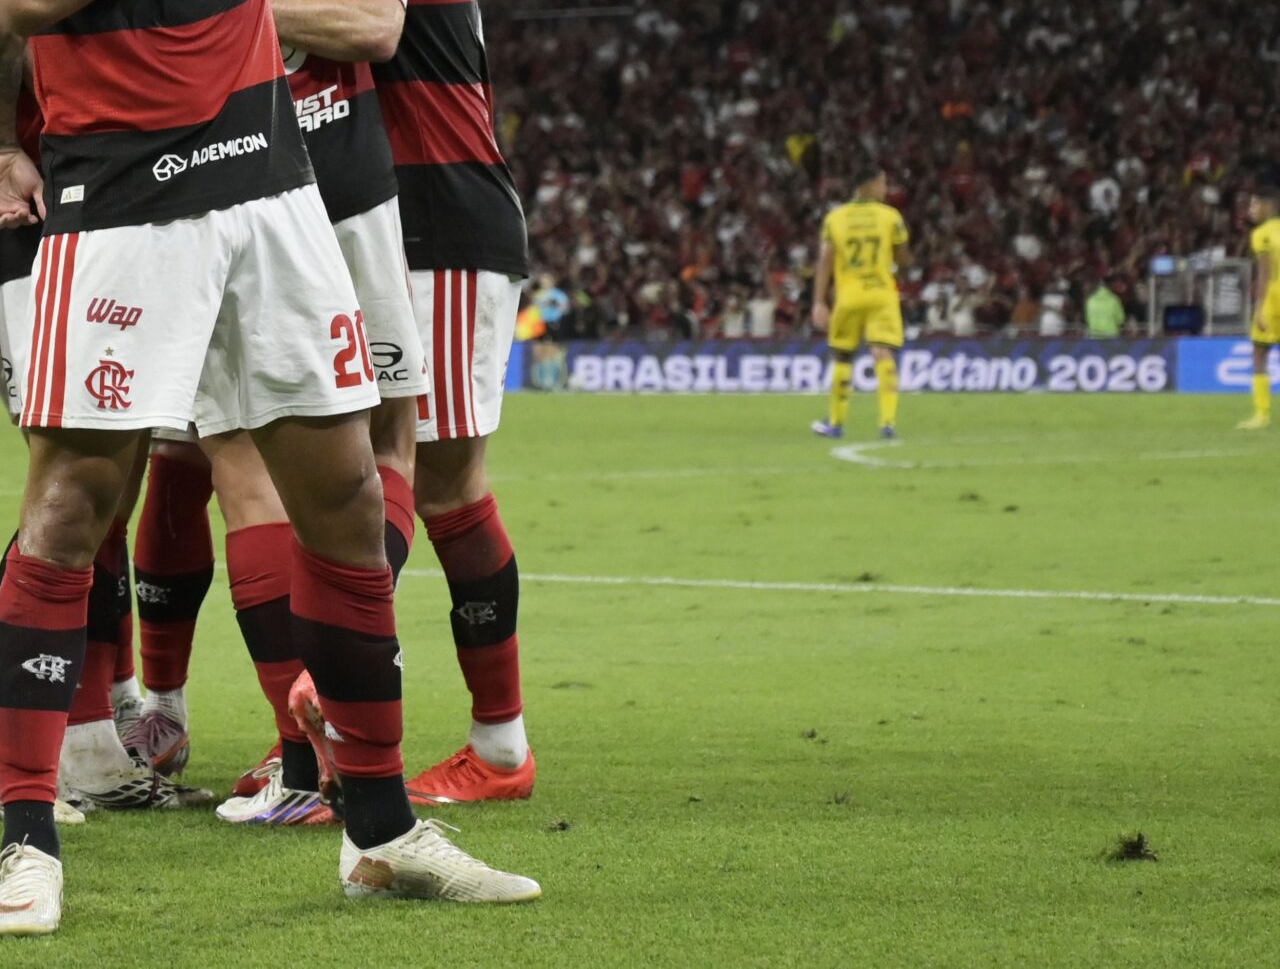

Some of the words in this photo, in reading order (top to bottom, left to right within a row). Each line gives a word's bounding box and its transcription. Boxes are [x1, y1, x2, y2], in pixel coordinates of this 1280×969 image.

[297, 99, 350, 133] ARD
[190, 132, 268, 168] ADEMICON
[846, 236, 882, 268] 27
[86, 297, 143, 331] Wap
[377, 369, 409, 382] AC
[899, 349, 1038, 392] Betano
[1047, 354, 1168, 392] 2026
